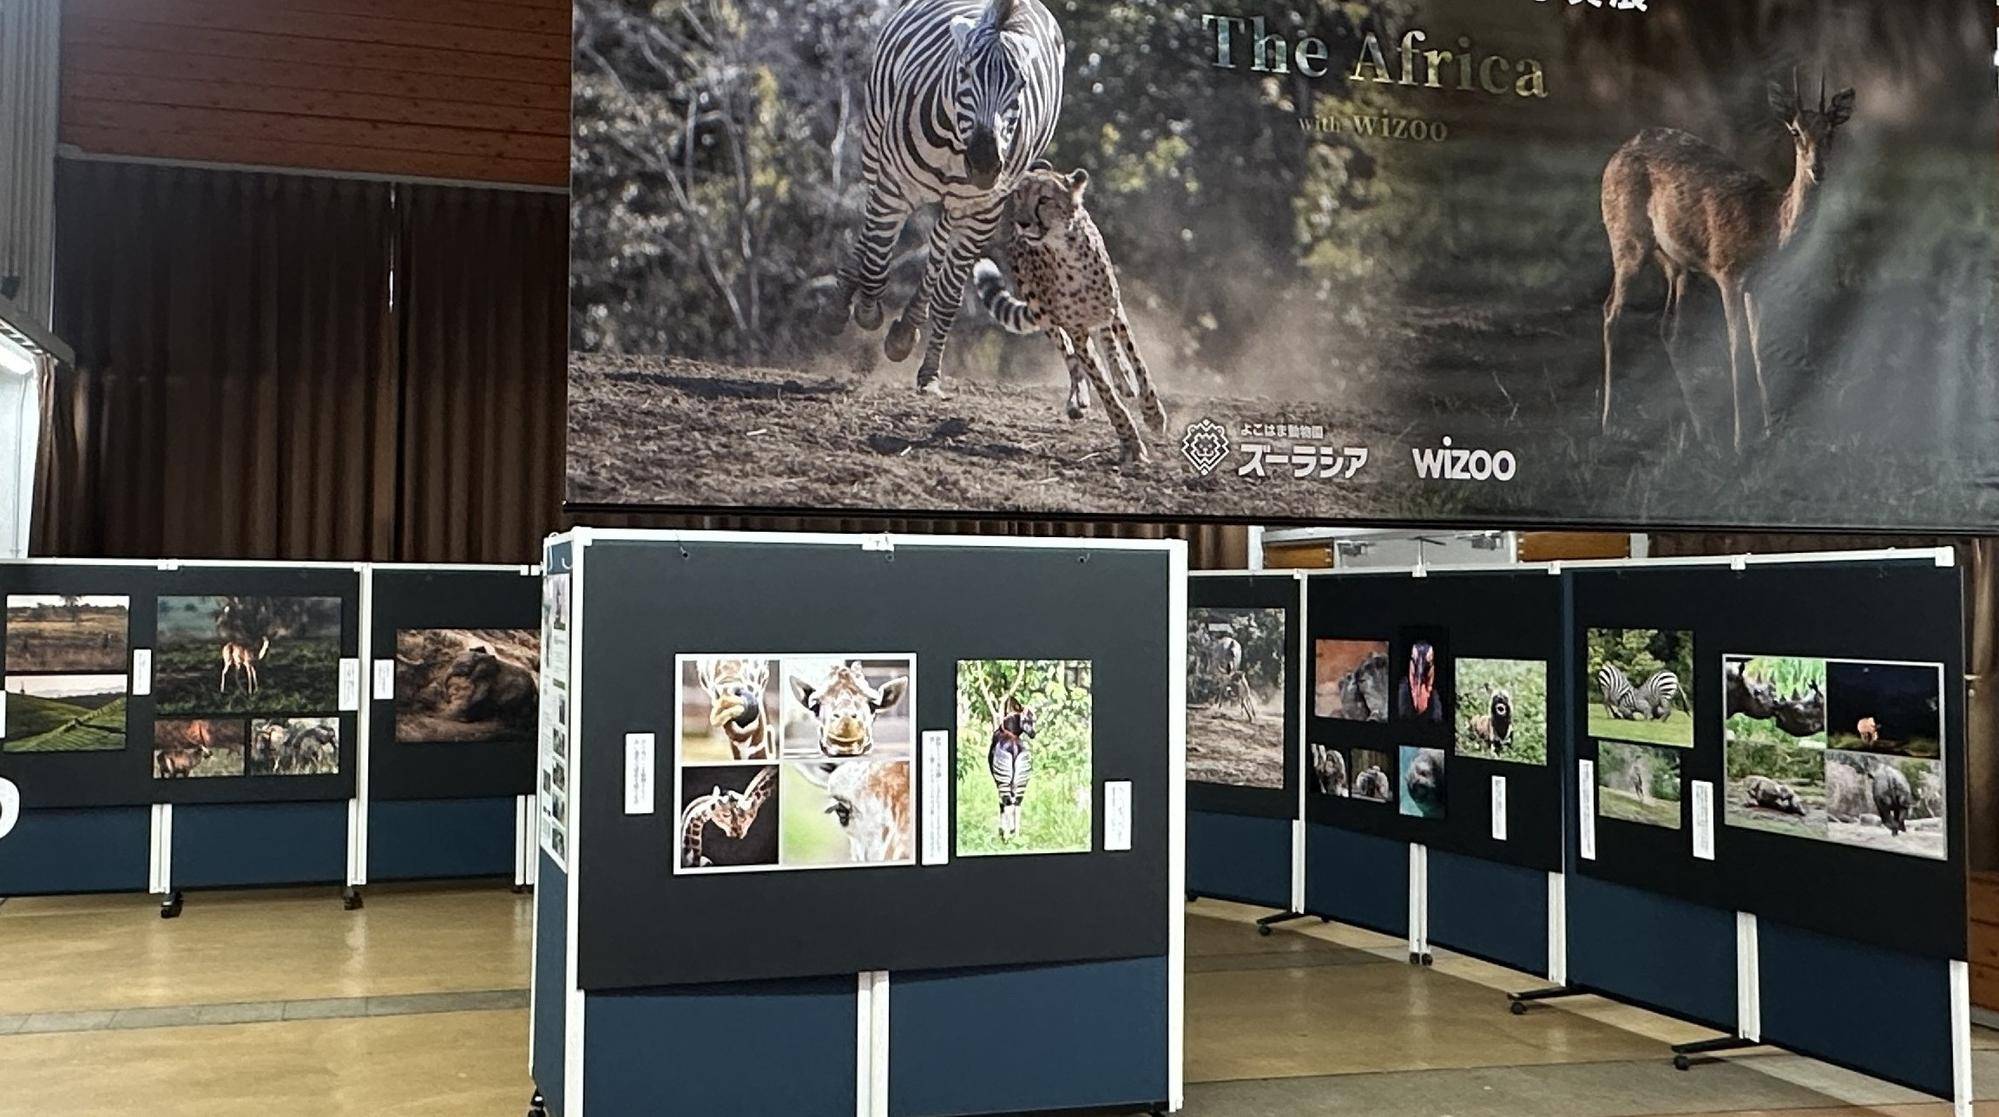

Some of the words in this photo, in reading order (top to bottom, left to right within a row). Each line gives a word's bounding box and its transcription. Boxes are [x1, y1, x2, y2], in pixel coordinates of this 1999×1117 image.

[1202, 14, 1328, 78] The
[1350, 30, 1549, 98] Africa
[1299, 114, 1341, 132] with
[1240, 423, 1324, 439] よこはま動物園
[1238, 444, 1368, 478] ズーラシア
[1412, 435, 1517, 481] wizoo
